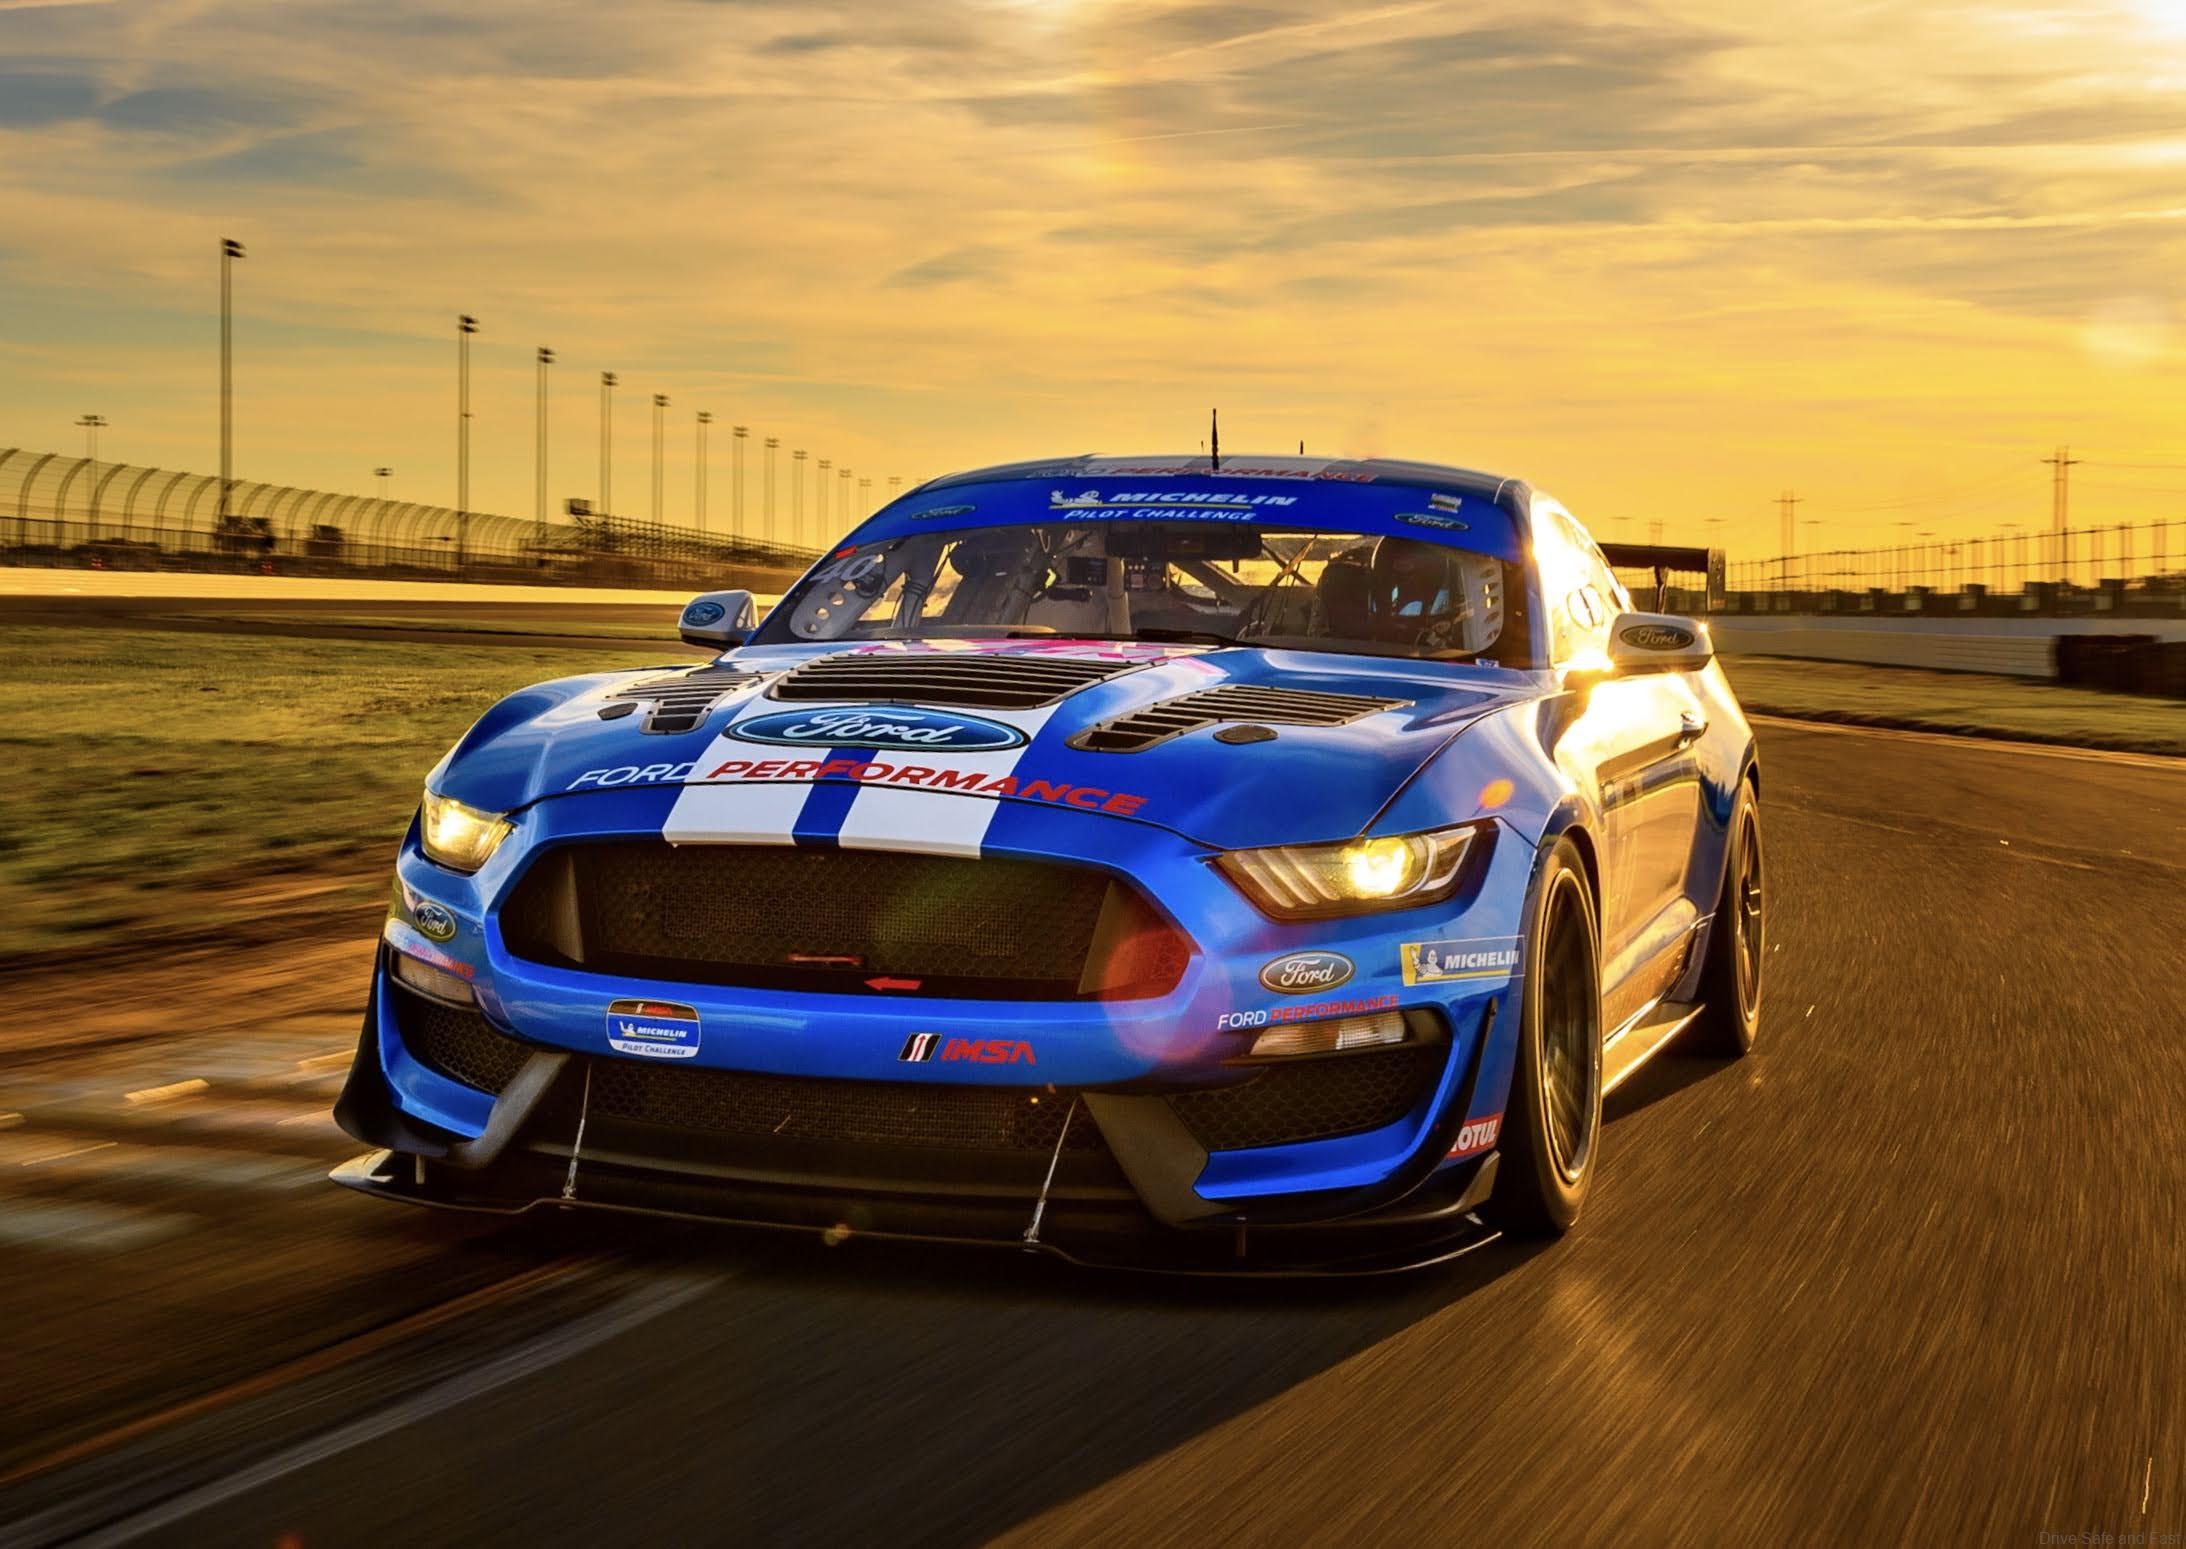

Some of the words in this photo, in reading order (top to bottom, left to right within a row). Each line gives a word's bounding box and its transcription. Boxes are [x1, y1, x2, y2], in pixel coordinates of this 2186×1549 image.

[1109, 493, 1298, 506] MICHELIN
[1063, 510, 1128, 519] PILOT
[1132, 508, 1256, 520] CHALLENGE
[783, 711, 960, 744] Ford
[566, 762, 700, 790] FORD
[706, 760, 1147, 816] PERFORMANCE
[421, 905, 448, 935] Ford
[1280, 959, 1334, 986] Ford
[1445, 950, 1520, 970] MICHELIN
[1217, 1010, 1266, 1030] FORD
[1270, 996, 1398, 1021] PERFORMANCE
[636, 1026, 688, 1038] MICHELIN
[622, 1043, 642, 1051] PILOT
[645, 1045, 686, 1056] CHALLENGE
[941, 1038, 1036, 1065] IMSA
